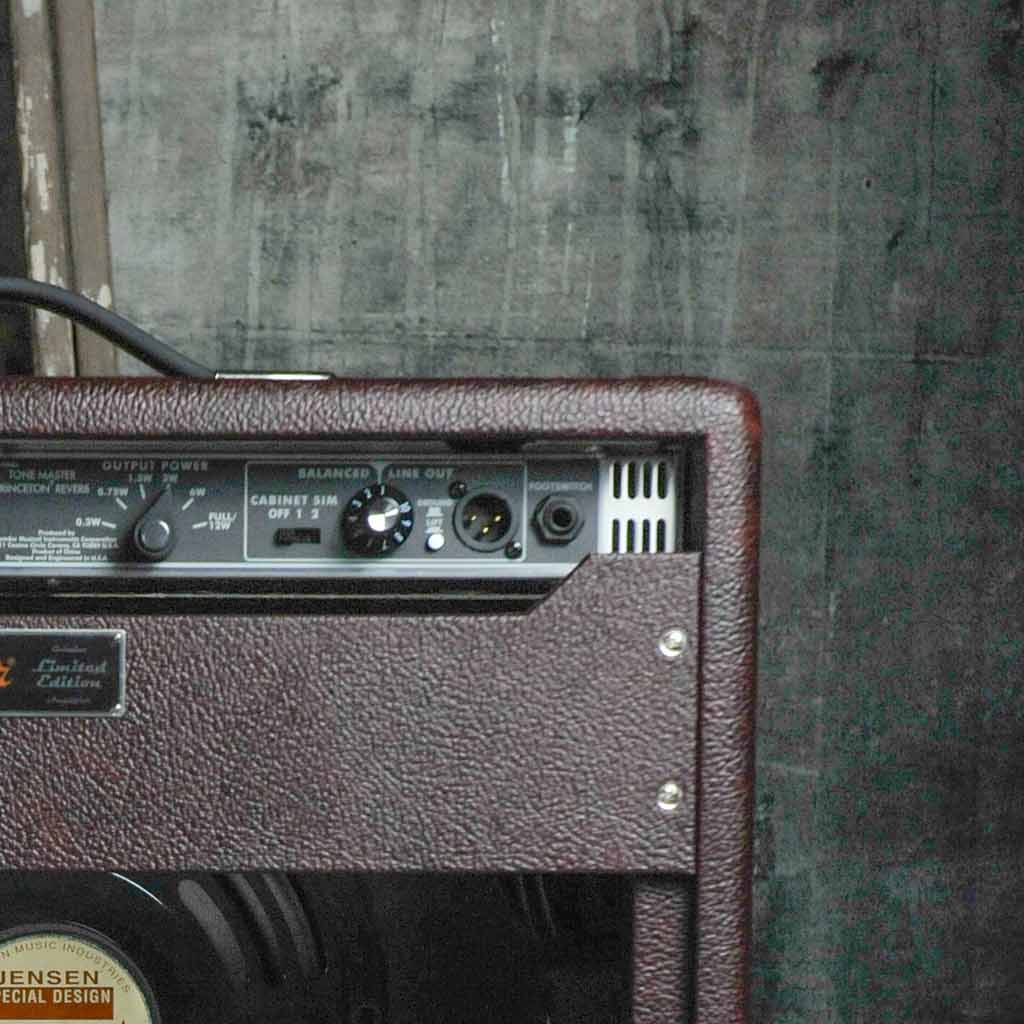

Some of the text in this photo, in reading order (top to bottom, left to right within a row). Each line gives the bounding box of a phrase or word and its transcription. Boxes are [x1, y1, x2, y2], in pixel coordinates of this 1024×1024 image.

[102, 461, 209, 471] OUTPUT POWER
[9, 470, 76, 480] TONE MASTER
[298, 467, 454, 479] BALANCED LINE OUT
[56, 483, 90, 494] REVERB
[250, 494, 338, 506] CABINET SIM
[268, 507, 319, 519] OFF 1 2
[32, 658, 108, 673] Limited
[36, 674, 102, 688] Edition
[14, 940, 57, 953] MUSIC
[62, 943, 131, 993] INDUSTRIES
[52, 988, 112, 1004] DESIGN
